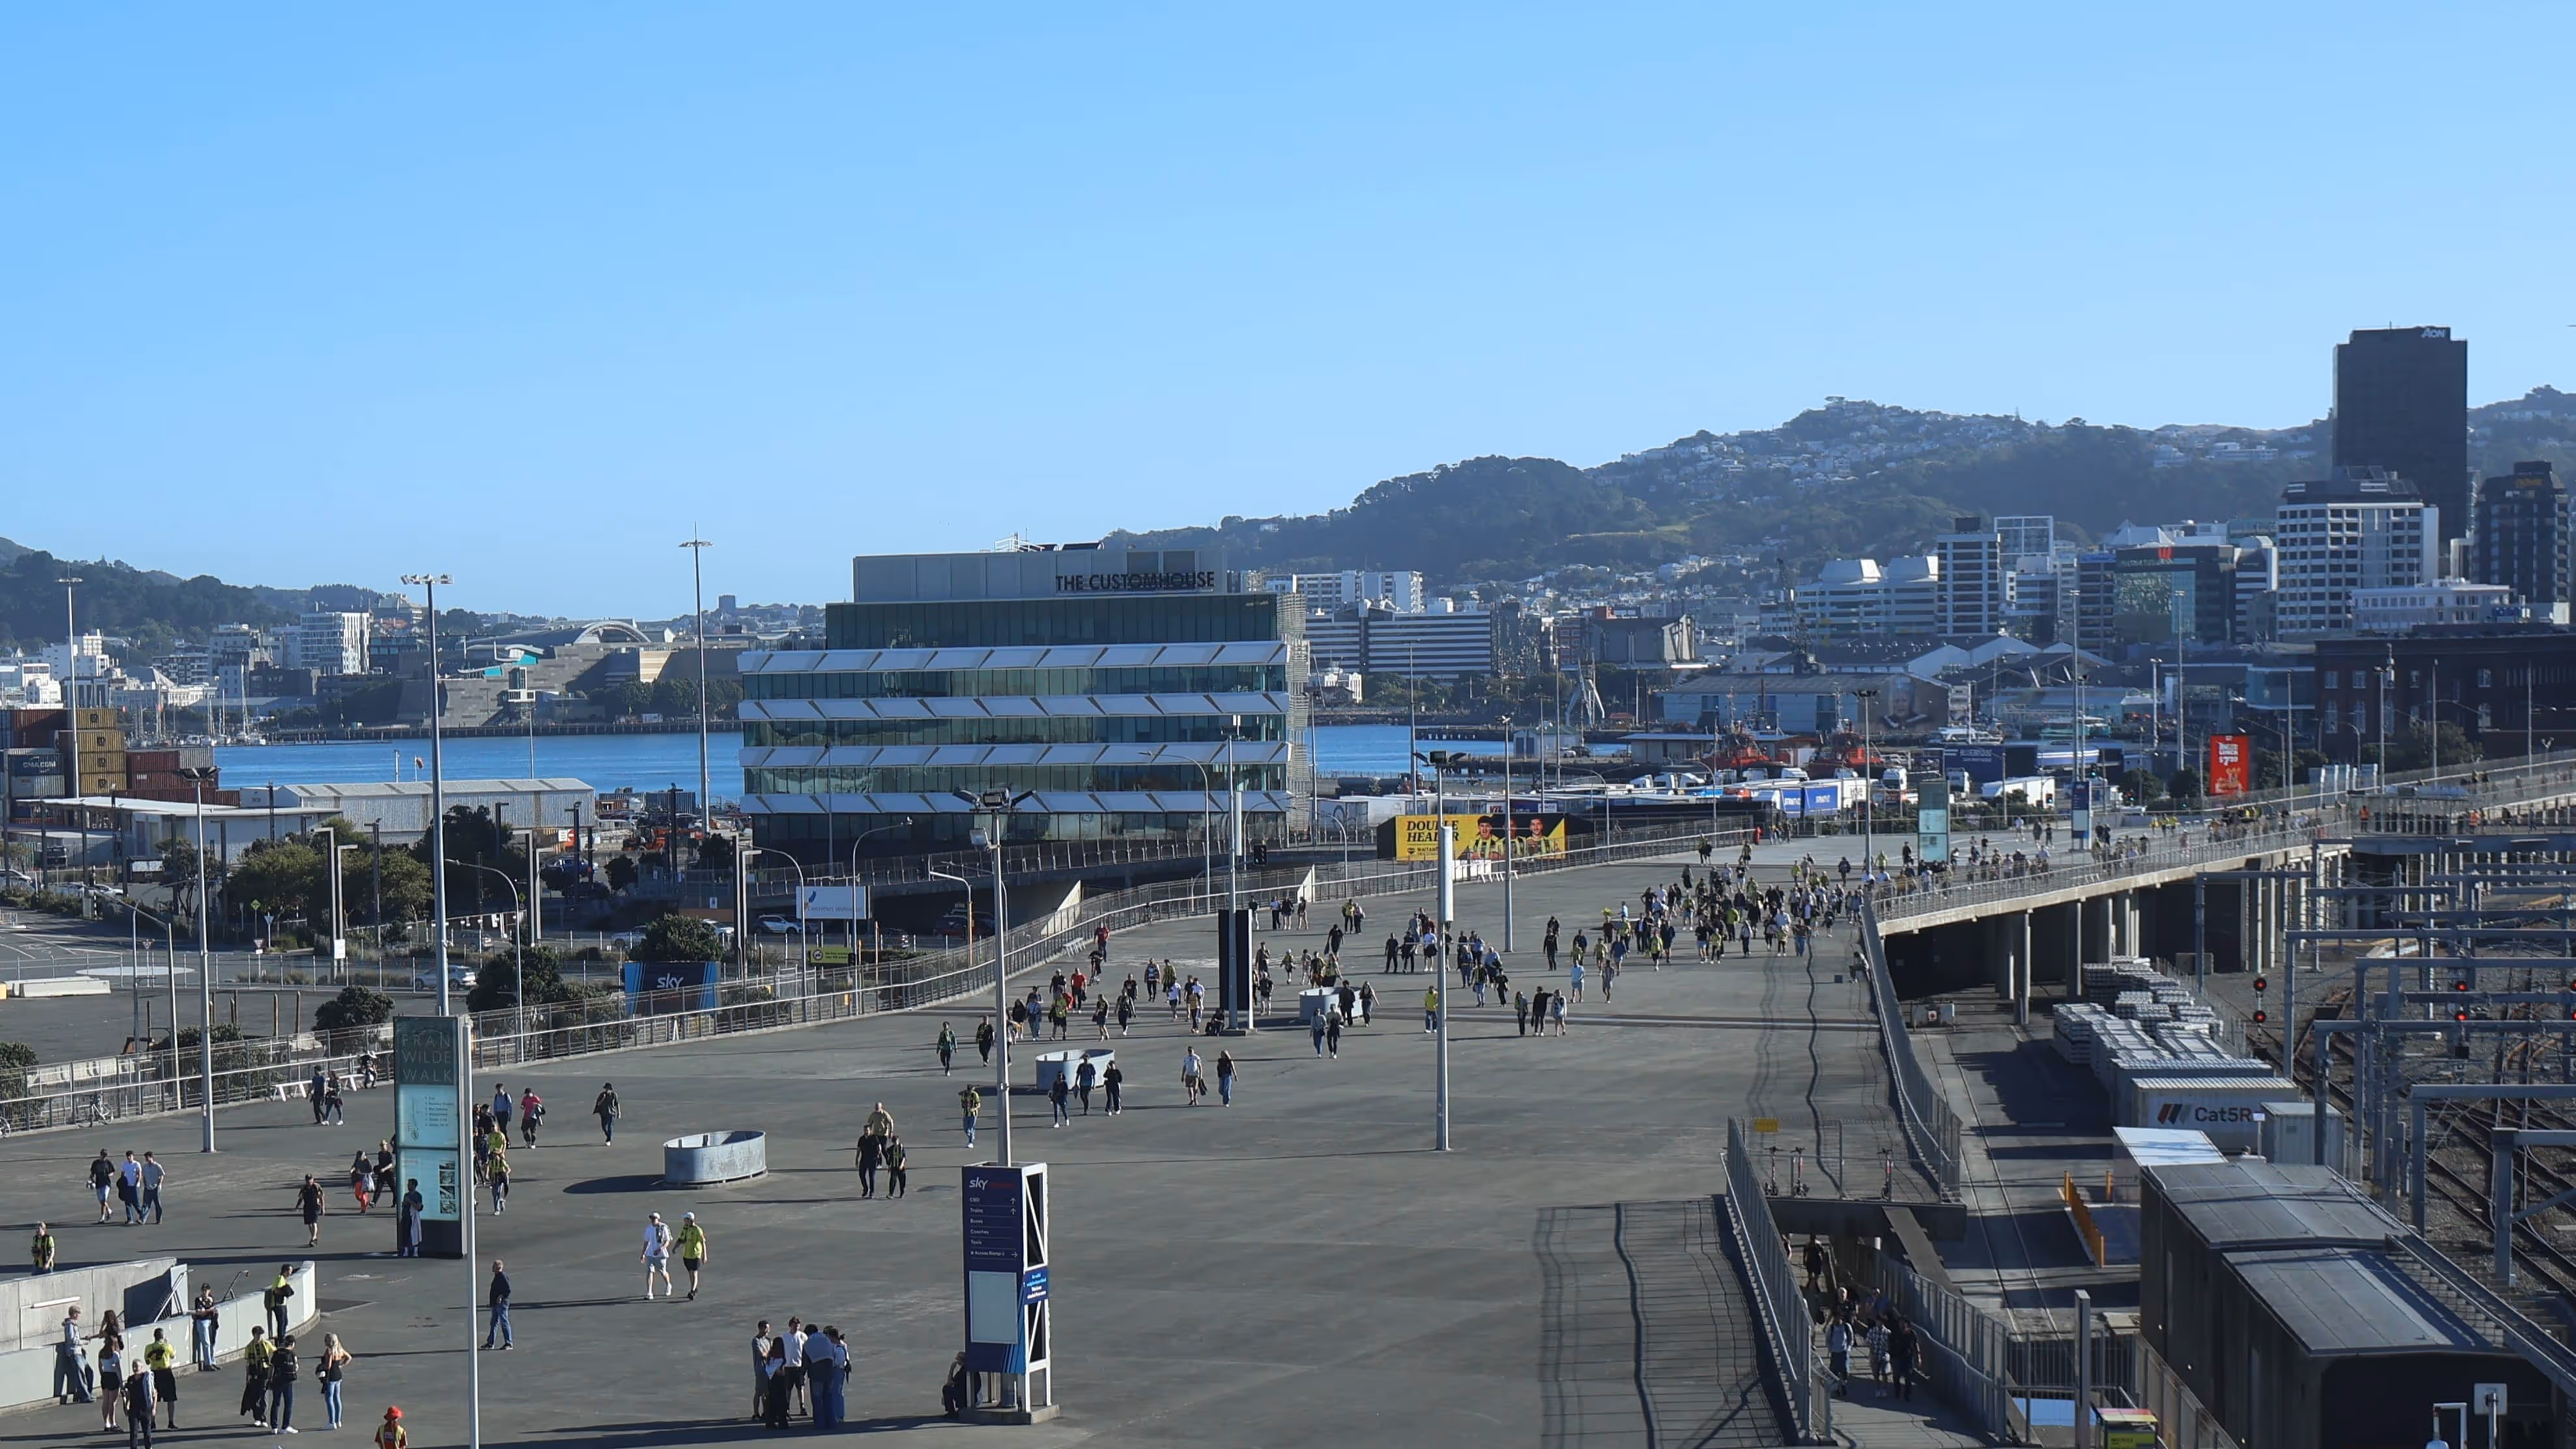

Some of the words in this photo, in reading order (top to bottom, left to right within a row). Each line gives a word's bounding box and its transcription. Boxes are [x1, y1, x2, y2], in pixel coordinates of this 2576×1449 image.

[1055, 575, 1083, 591] THE
[1089, 571, 1215, 590] CUSTOMHOUSE
[1407, 831, 1459, 842] HEAR
[657, 973, 683, 990] sky
[401, 1032, 450, 1048] FRAN
[401, 1050, 451, 1064] WILDE
[402, 1068, 452, 1082] WALK
[969, 1177, 989, 1190] sky
